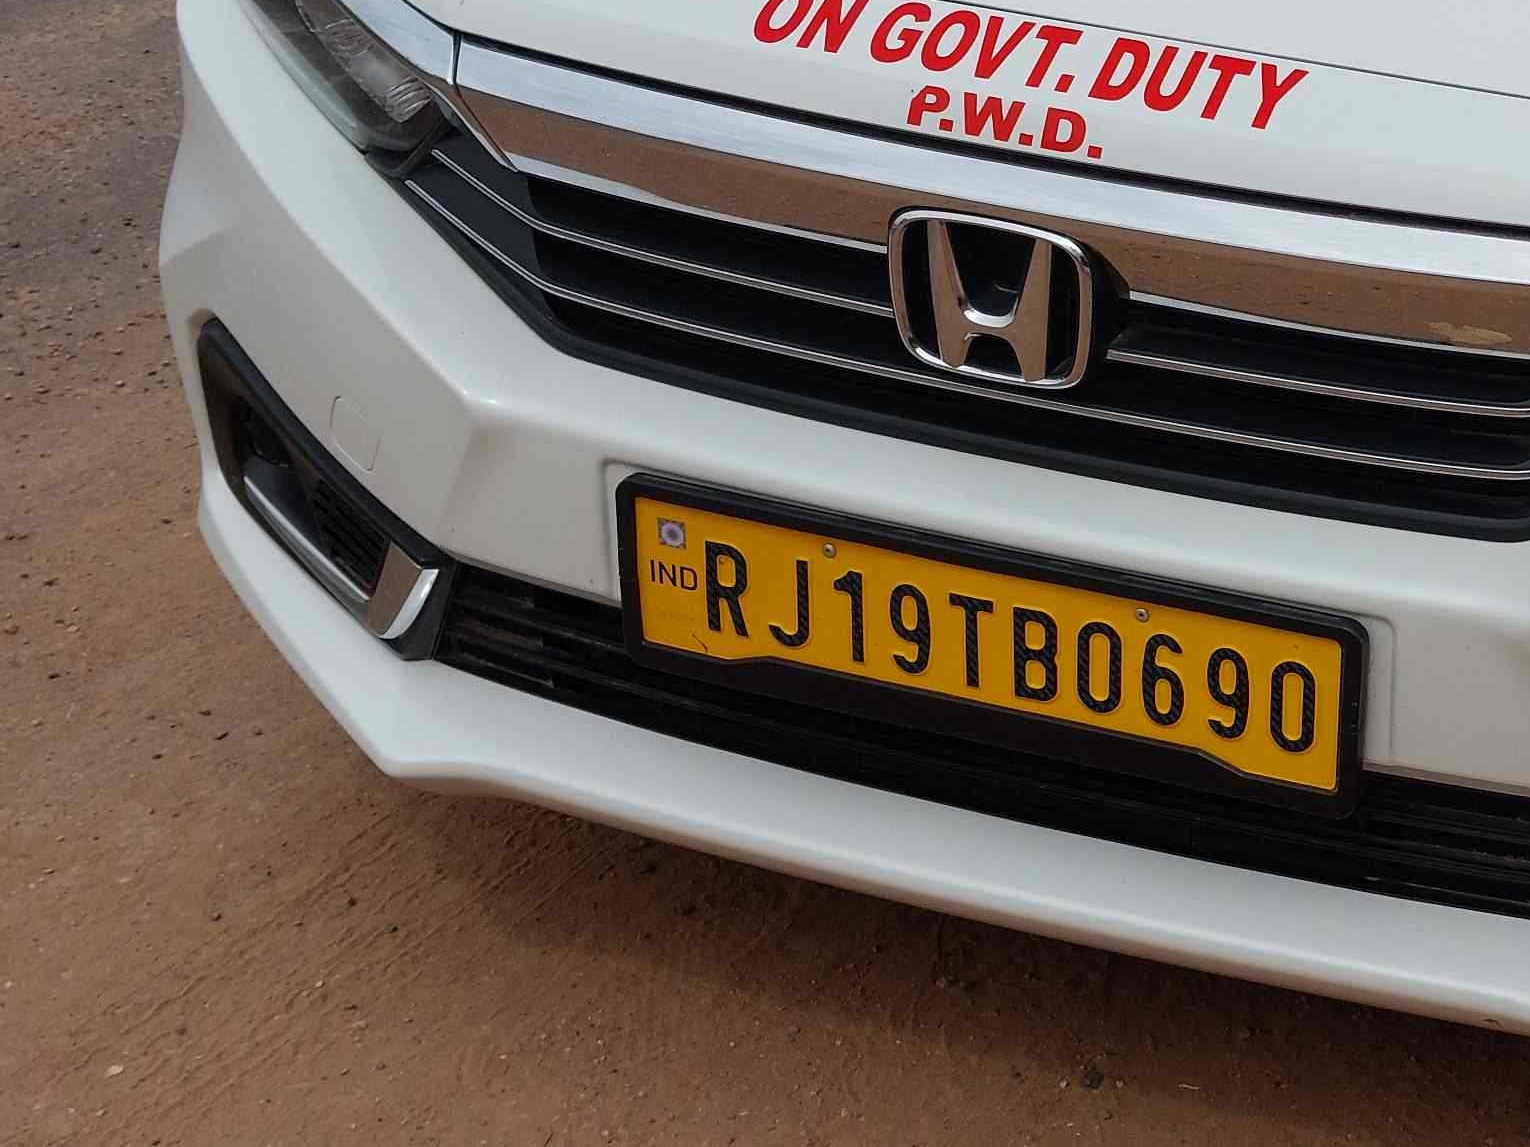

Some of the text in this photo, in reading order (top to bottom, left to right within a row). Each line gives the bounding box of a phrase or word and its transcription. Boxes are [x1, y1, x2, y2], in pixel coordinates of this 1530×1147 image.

[869, 1, 1083, 93] GOVT.
[1088, 37, 1309, 131] DUTY
[906, 85, 1104, 159] P.W.D.
[650, 559, 698, 591] IND
[704, 540, 1317, 754] RJ19TB0690
